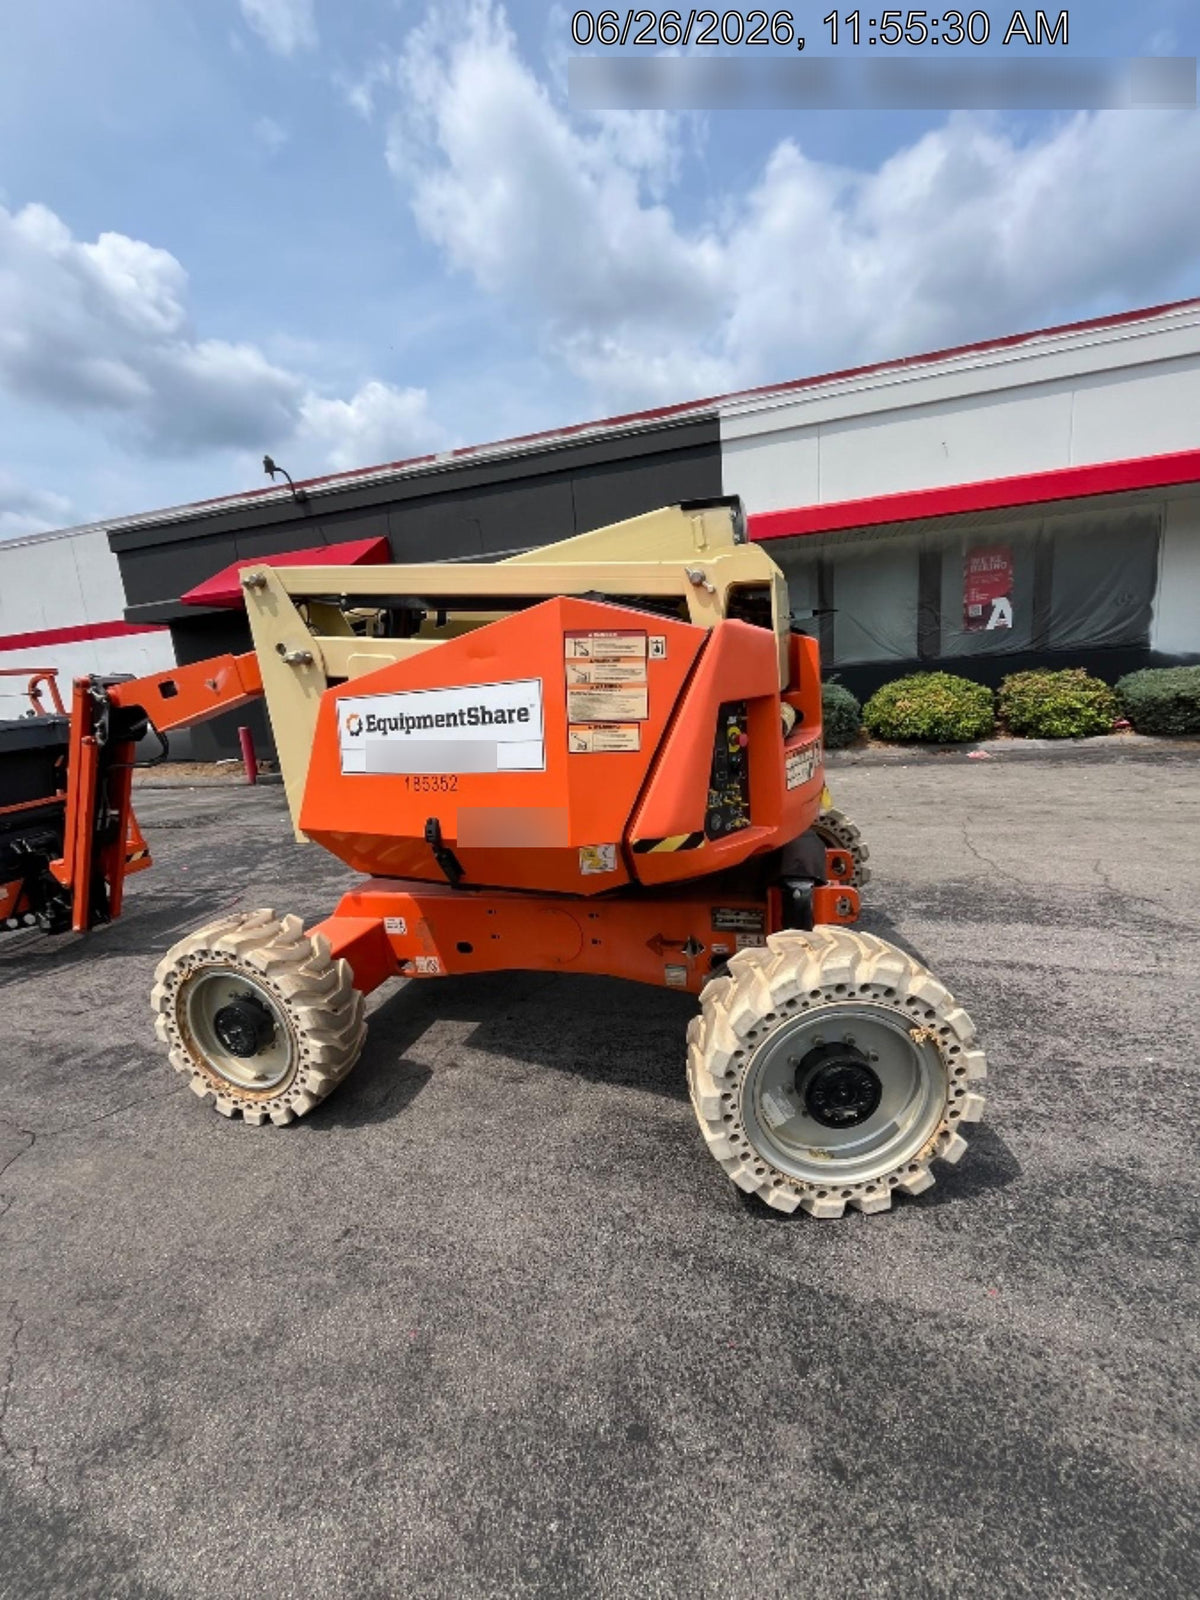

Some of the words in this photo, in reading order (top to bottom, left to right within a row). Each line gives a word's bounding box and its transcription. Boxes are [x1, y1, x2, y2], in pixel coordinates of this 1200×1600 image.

[985, 596, 1013, 630] A
[365, 705, 530, 735] EquipmentShare
[405, 774, 458, 792] 185352
